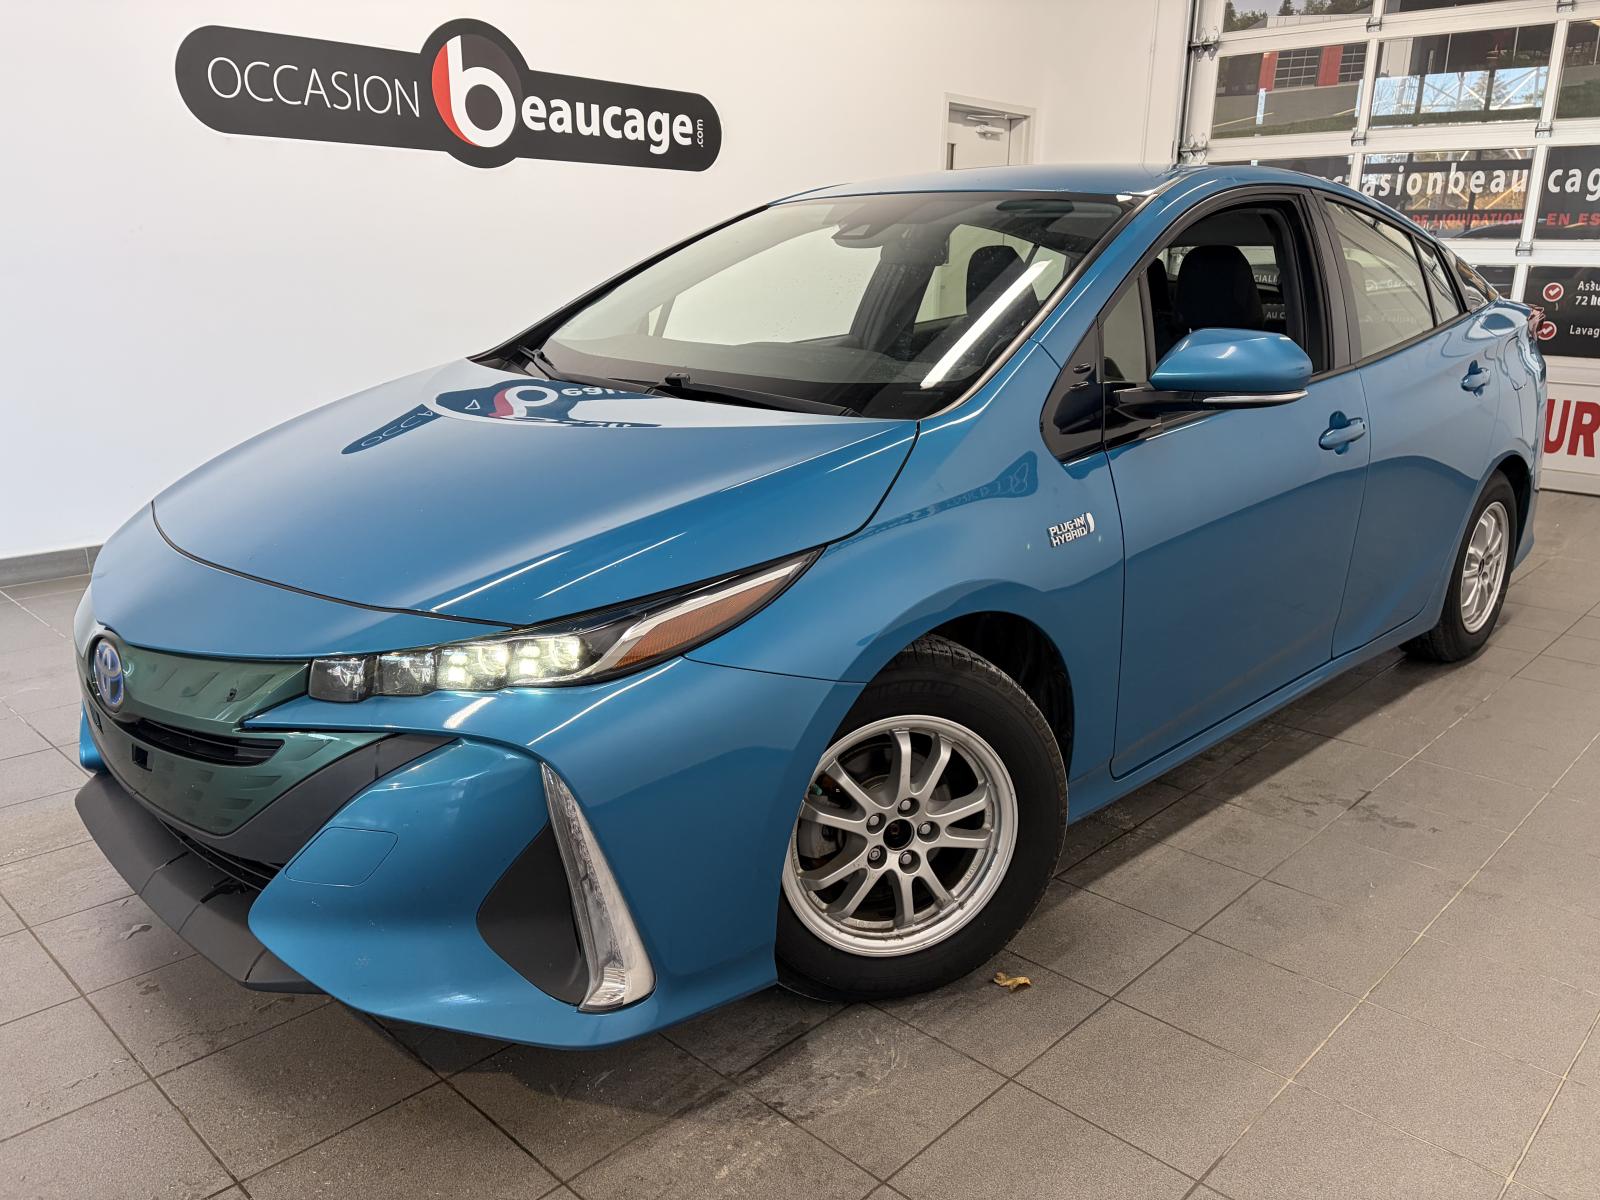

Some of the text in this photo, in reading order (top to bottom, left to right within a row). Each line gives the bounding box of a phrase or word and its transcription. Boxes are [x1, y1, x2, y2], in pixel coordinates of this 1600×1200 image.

[207, 56, 420, 118] OCCASION
[1320, 163, 1529, 197] asionbeau
[1434, 212, 1524, 226] LIQUIDATION
[1546, 212, 1571, 226] EN
[1575, 295, 1588, 306] 72
[1049, 515, 1085, 537] PLUG-IN
[1051, 526, 1087, 547] HYBRID
